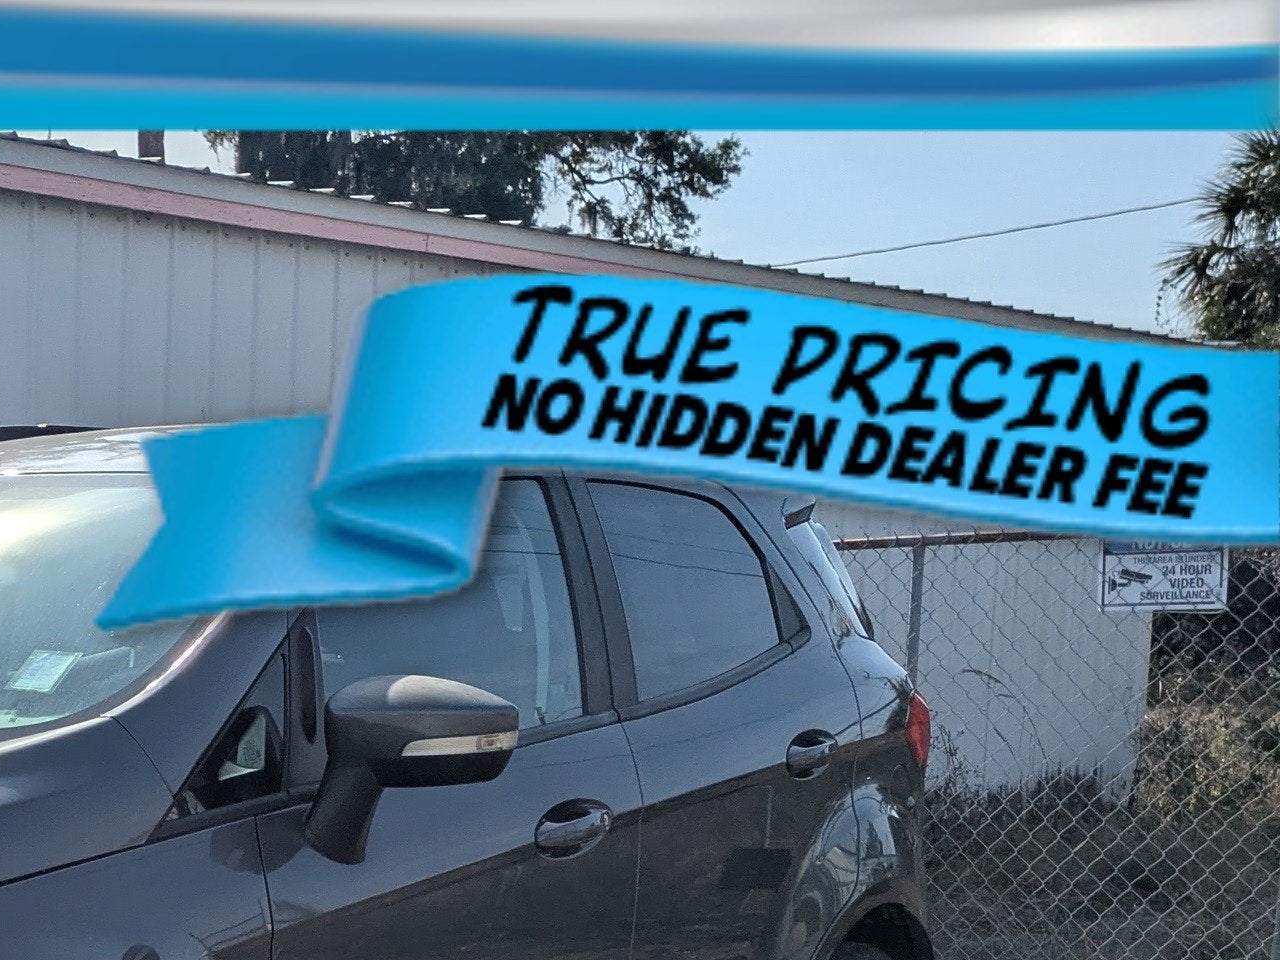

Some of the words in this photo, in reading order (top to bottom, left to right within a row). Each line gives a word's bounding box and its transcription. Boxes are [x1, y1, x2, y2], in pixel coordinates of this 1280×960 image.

[1151, 555, 1173, 564] AREA
[1162, 565, 1175, 576] 24
[1180, 564, 1212, 575] HOUR
[1170, 577, 1204, 589] VIDEO
[1140, 590, 1211, 600] SURVEILLANCE
